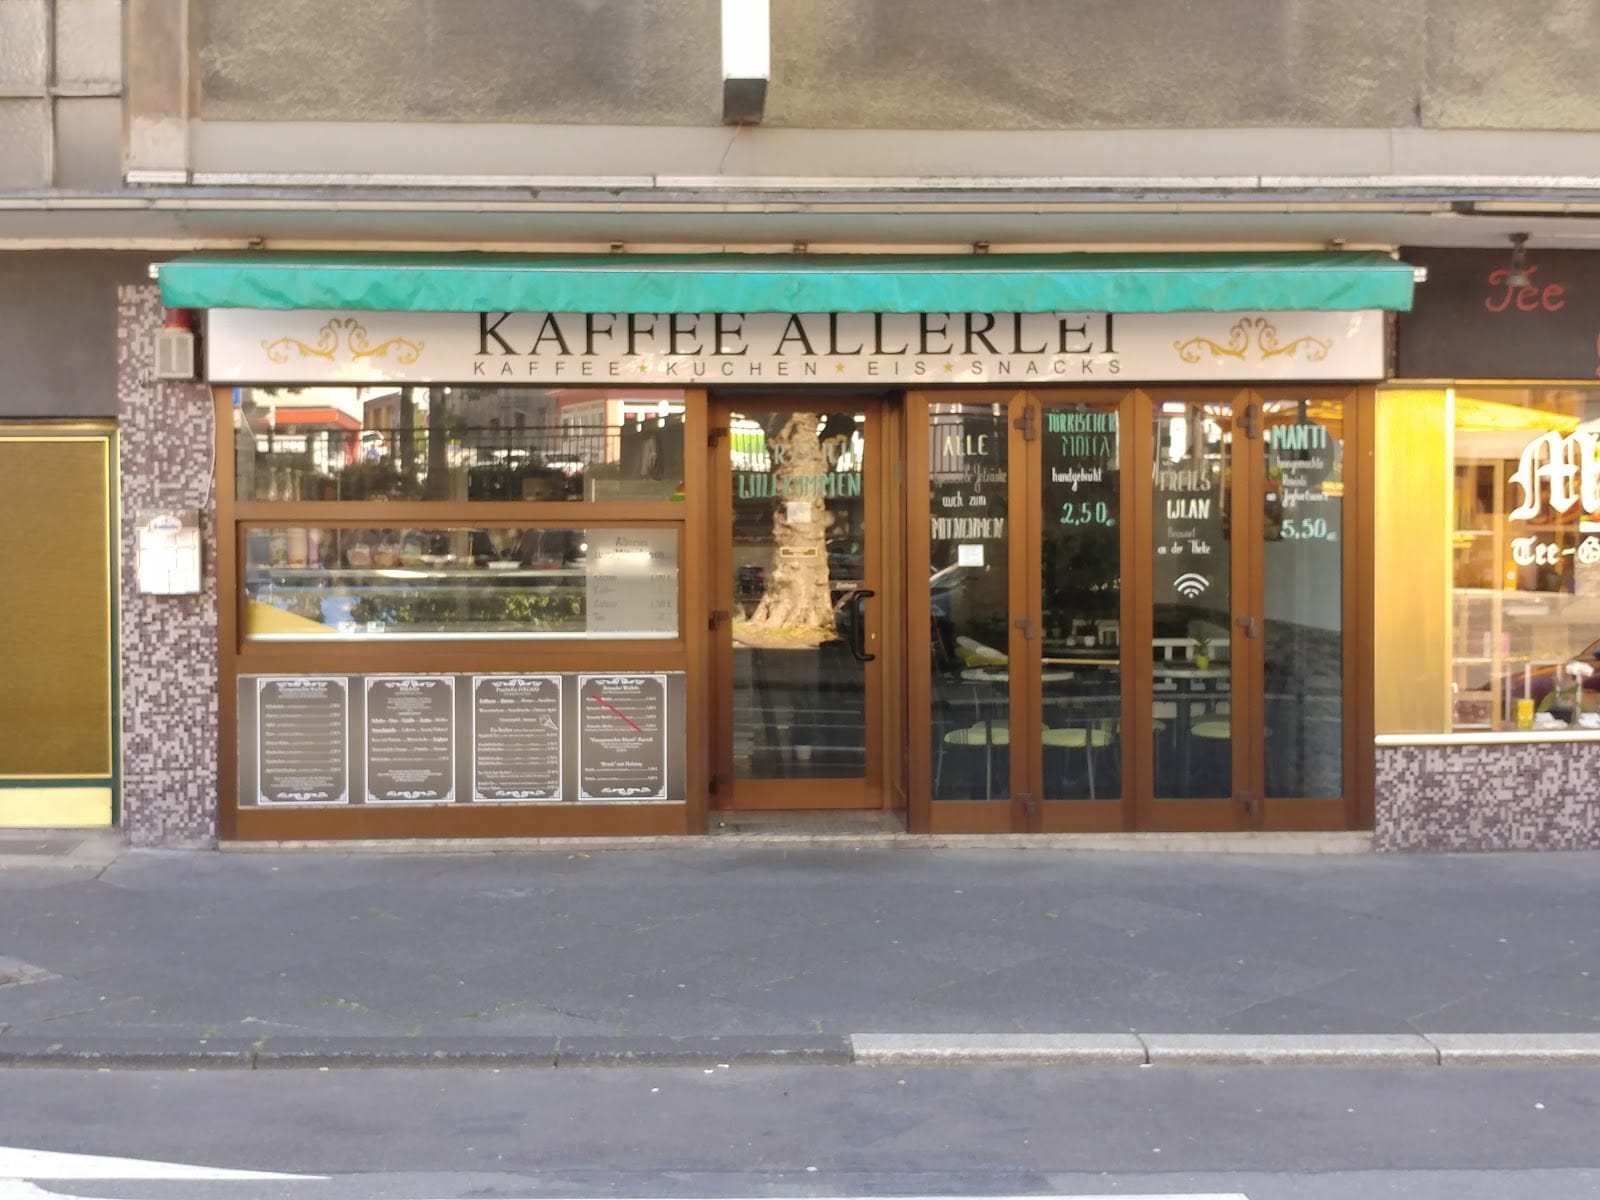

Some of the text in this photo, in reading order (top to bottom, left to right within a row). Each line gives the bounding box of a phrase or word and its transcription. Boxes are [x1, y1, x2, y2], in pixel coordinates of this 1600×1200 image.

[1485, 265, 1566, 312] Tee
[474, 311, 1120, 356] KAFFEE ALLERLEI
[473, 360, 1121, 376] KAFFEE KUCHEN EIS SNACKS
[943, 434, 989, 456] ALLE
[1271, 424, 1327, 450] MANTI
[738, 473, 861, 499] WILLKOMMEN
[1159, 469, 1211, 492] FREIES
[1167, 498, 1211, 519] WLAN
[931, 517, 1004, 539] MITNEHMEN
